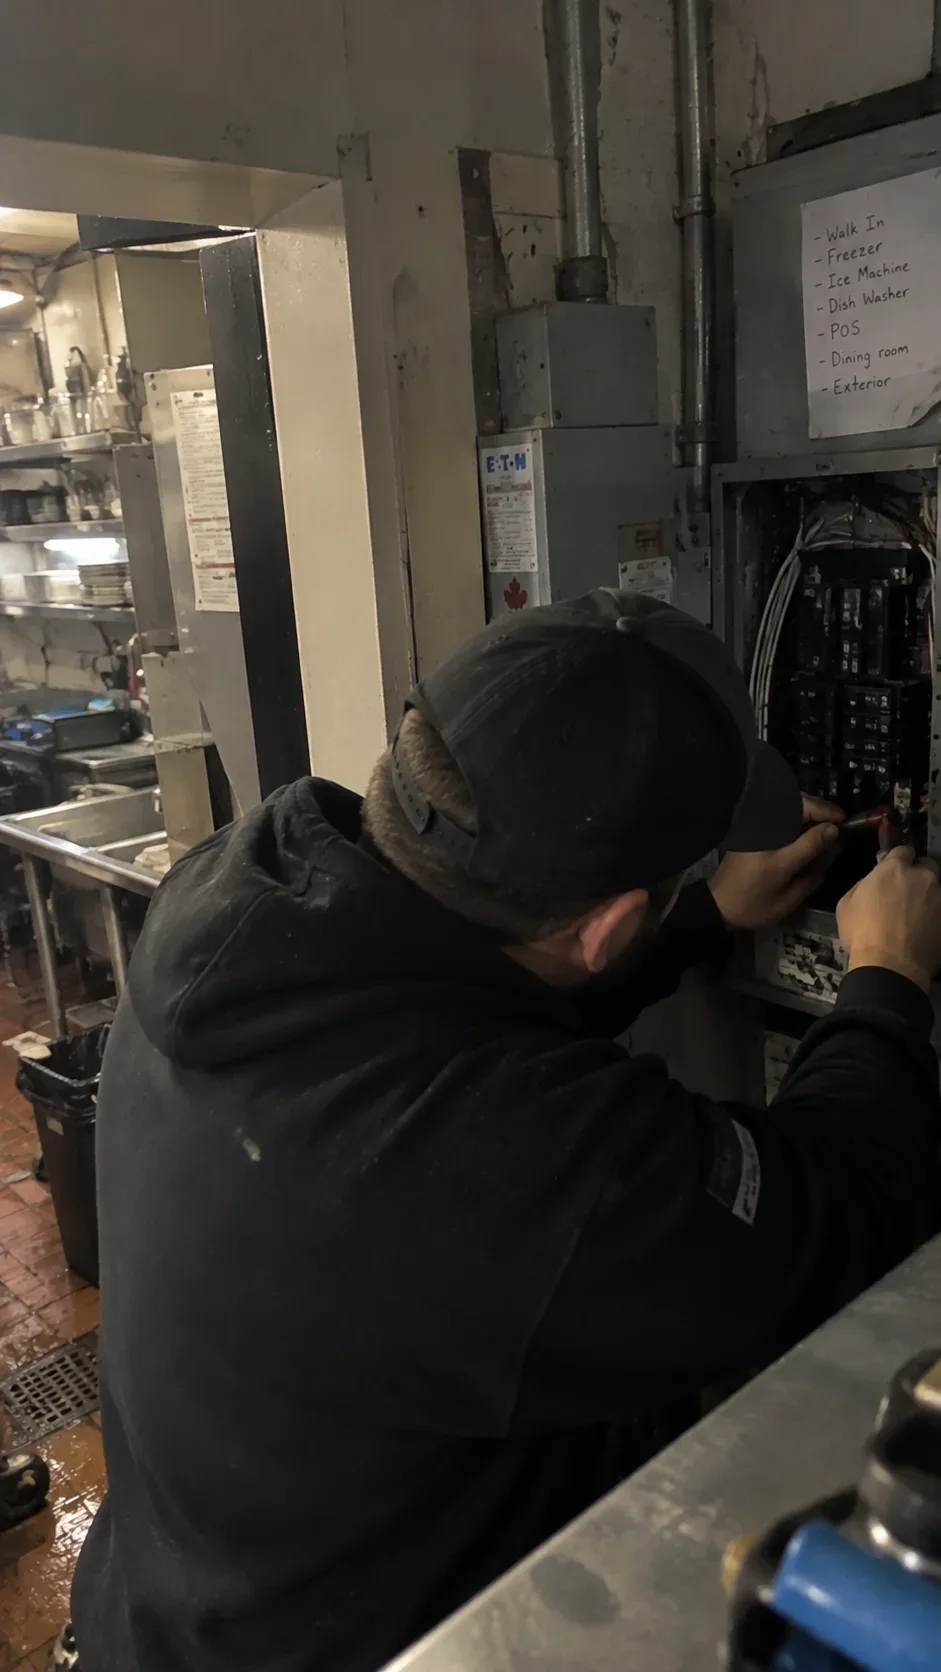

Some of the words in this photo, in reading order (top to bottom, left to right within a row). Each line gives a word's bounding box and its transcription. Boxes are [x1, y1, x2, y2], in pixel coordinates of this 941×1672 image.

[826, 221, 859, 243] Walk
[865, 214, 885, 232] In
[827, 241, 884, 265] Freezer
[828, 273, 851, 290] Ice
[858, 262, 911, 283] Machine
[829, 296, 856, 314] Dish
[862, 287, 910, 306] Washer
[830, 320, 861, 340] POS
[831, 350, 871, 369] Dining
[878, 344, 910, 359] room
[833, 375, 892, 396] Exterior
